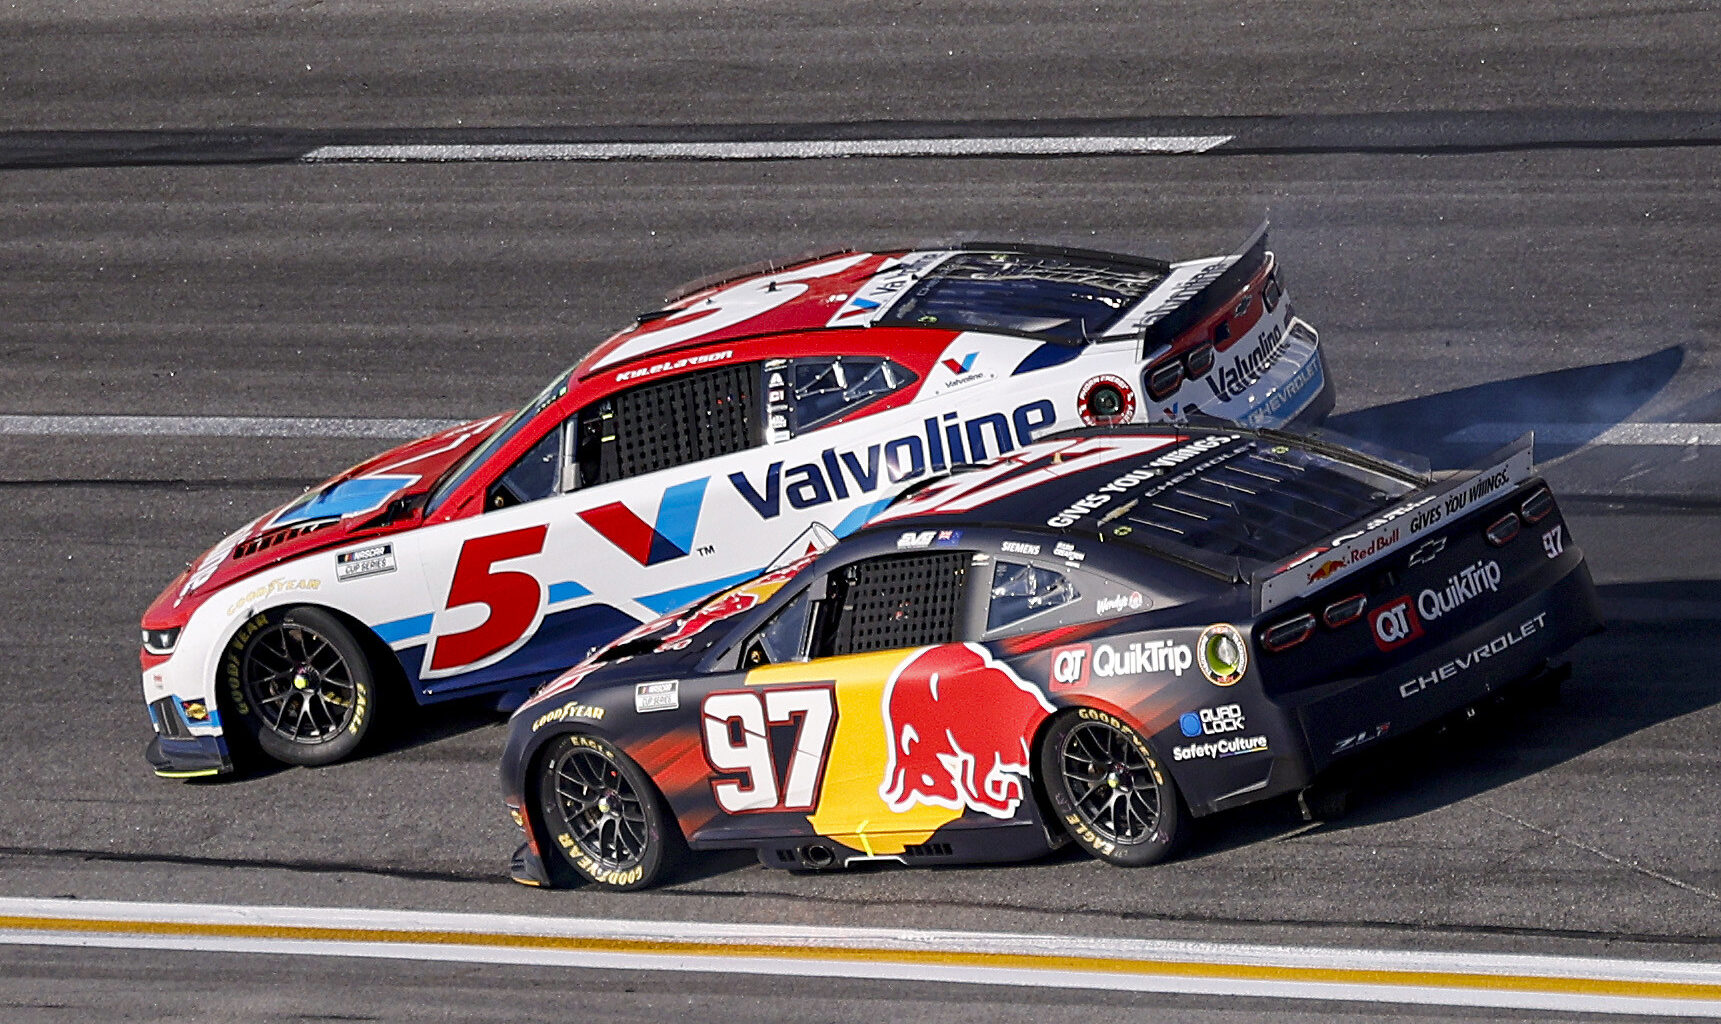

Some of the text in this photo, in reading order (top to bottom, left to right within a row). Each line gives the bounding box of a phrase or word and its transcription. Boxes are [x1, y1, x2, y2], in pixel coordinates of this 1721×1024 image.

[945, 373, 983, 388] Valvoline
[728, 398, 1056, 521] Valvoline
[1046, 493, 1112, 528] GIVES
[1099, 468, 1155, 493] YOU
[697, 544, 716, 558] TM
[1001, 541, 1040, 555] SIEMENS
[1351, 541, 1375, 563] Red
[1376, 527, 1399, 551] Bull
[1409, 504, 1442, 534] GIVES
[1444, 490, 1467, 517] YOU
[1542, 524, 1564, 559] 97
[430, 523, 549, 671] 5
[1376, 560, 1501, 643] QT QuikTrip
[1053, 649, 1086, 684] QT
[1092, 638, 1193, 677] QuikTrip
[1400, 612, 1546, 698] CHEVROLET
[532, 701, 606, 733] GOODYEAR
[1200, 704, 1242, 722] QUAD
[702, 681, 836, 815] 97
[1078, 708, 1165, 786] GOODYEAR
[1173, 736, 1268, 761] SafetyCulture
[557, 832, 644, 886] GOODYEAR
[1065, 813, 1116, 856] EAGLE
